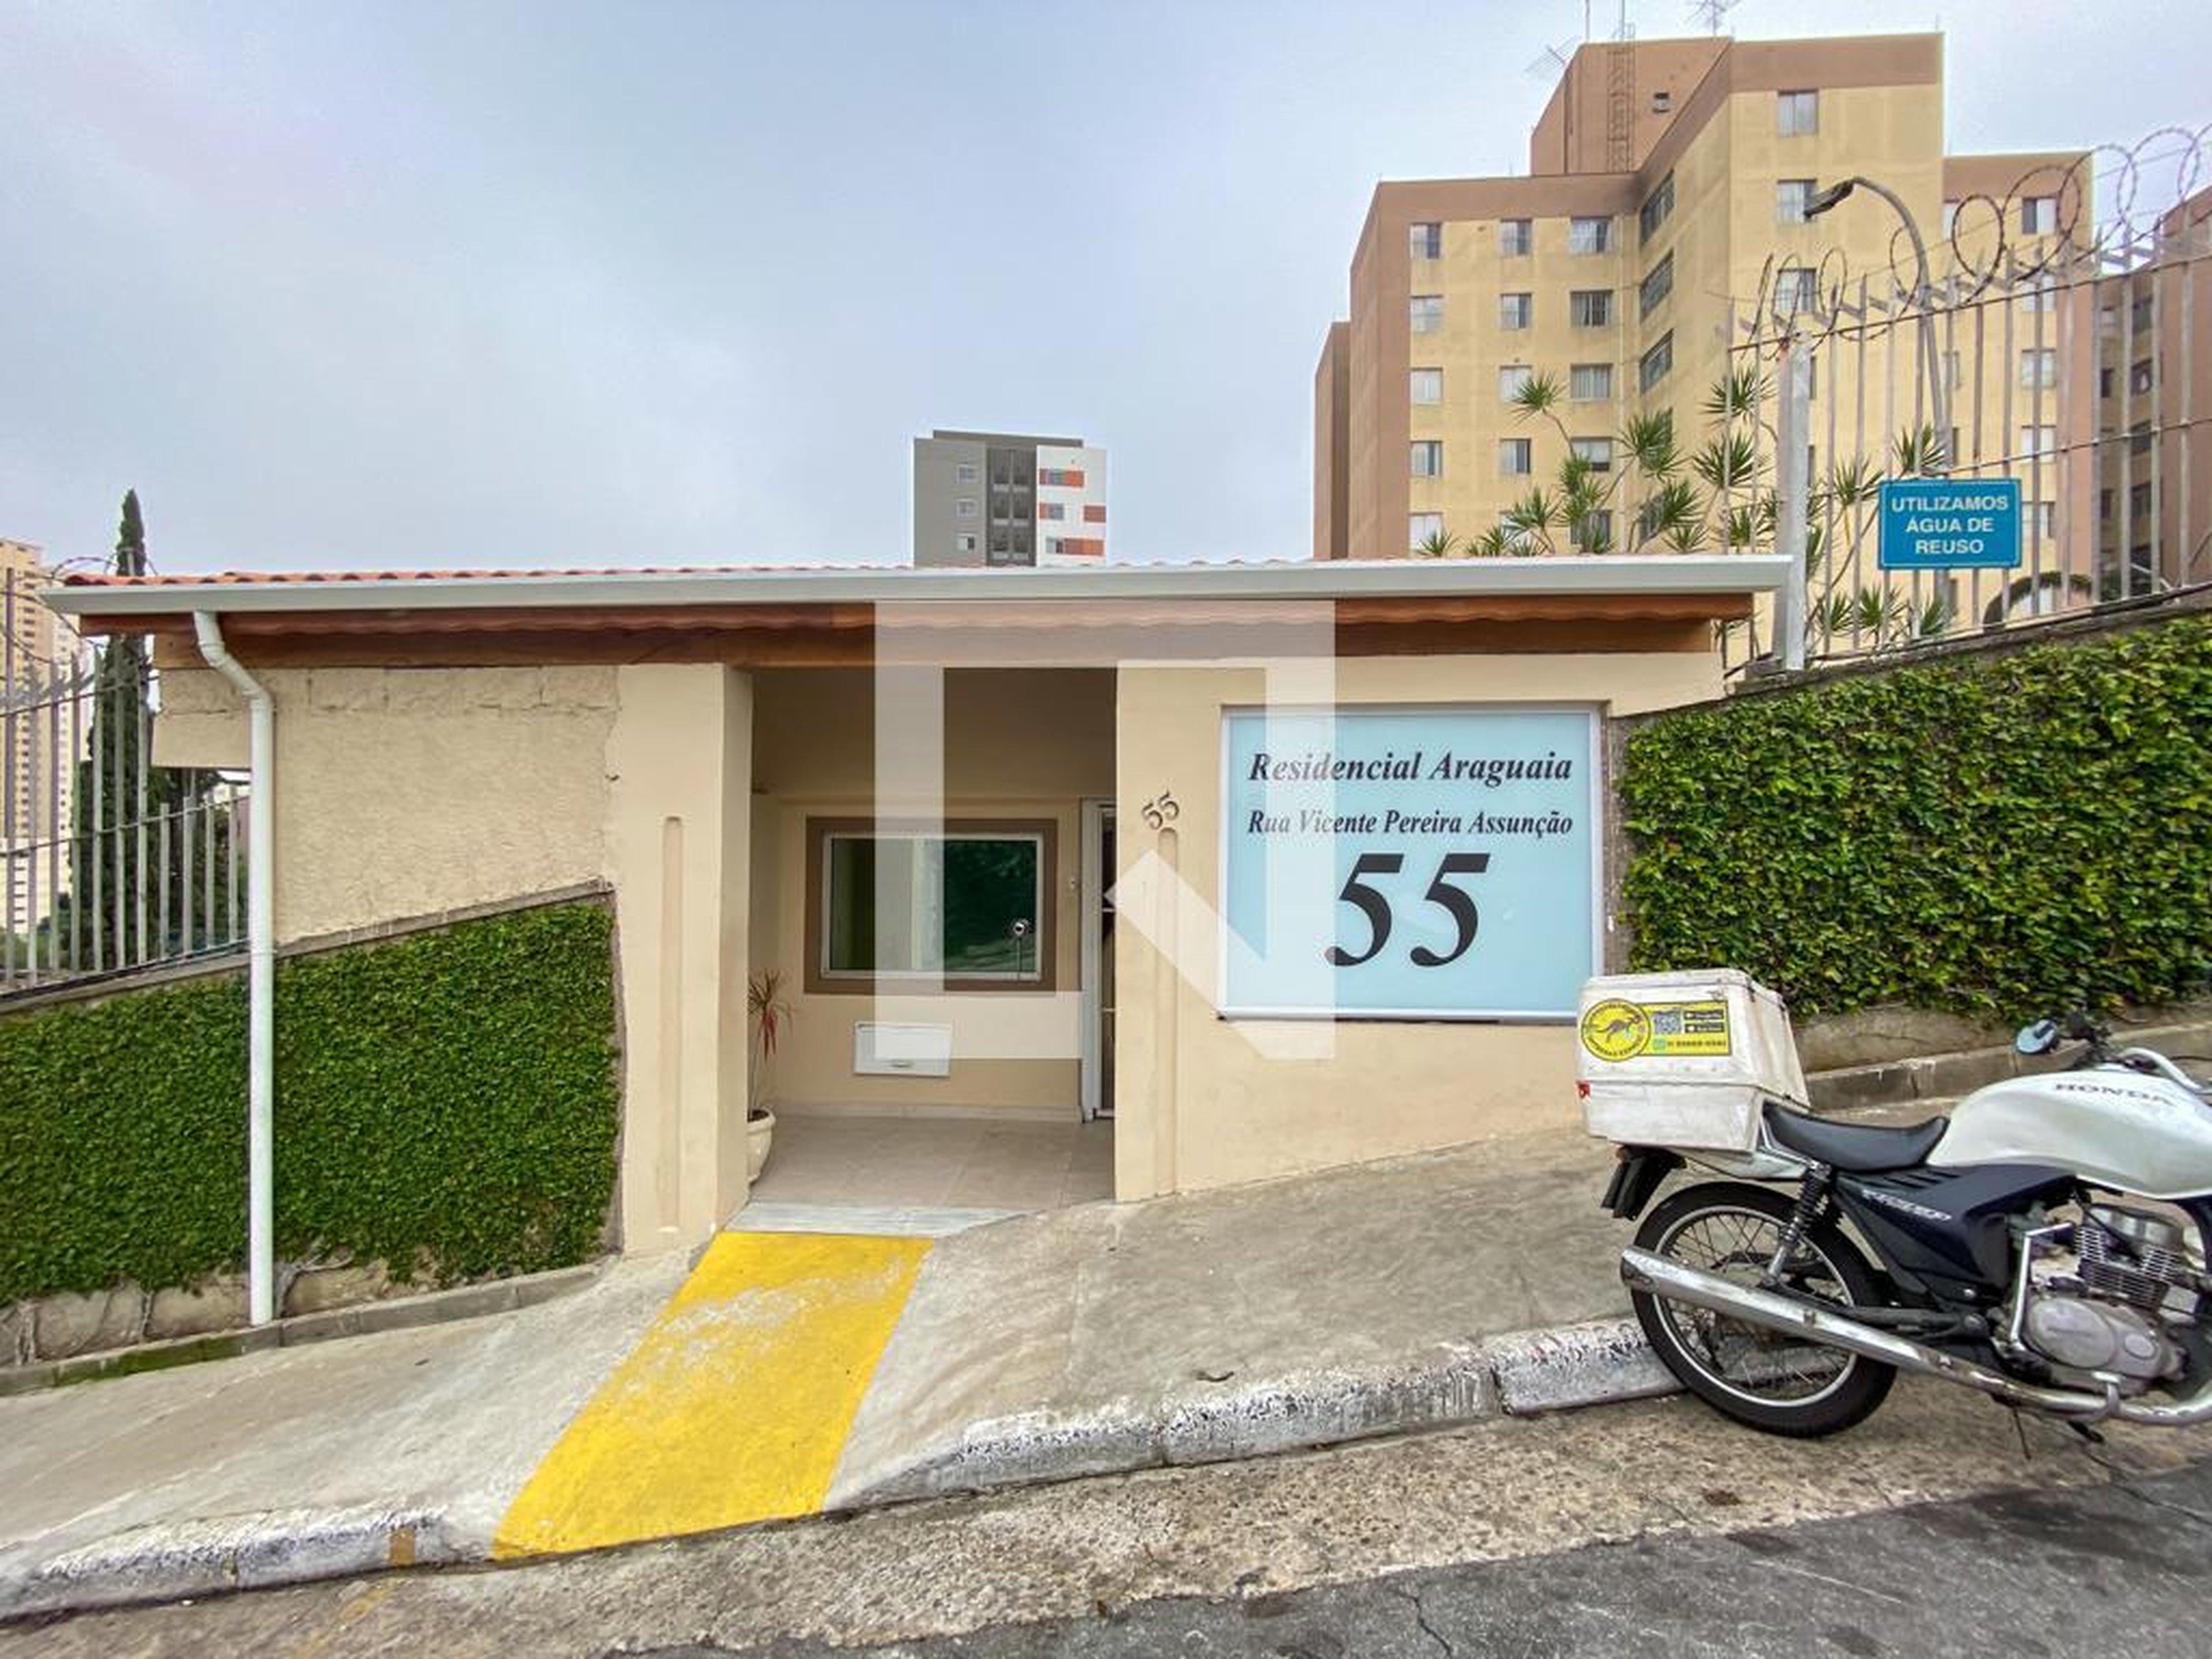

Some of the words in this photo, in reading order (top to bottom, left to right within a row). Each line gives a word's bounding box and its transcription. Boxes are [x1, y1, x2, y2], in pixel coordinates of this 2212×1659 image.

[1891, 495, 2009, 513] UTILIZAMOS
[1905, 514, 1963, 533] ÁGUA
[1967, 517, 1995, 533] DE
[1914, 539, 1985, 555] REUSO
[1248, 751, 1423, 781] Residencial
[1428, 751, 1573, 788] Araguaia
[1142, 789, 1179, 830] 55
[1248, 809, 1291, 834] Rua
[1298, 809, 1377, 834] Vicente
[1383, 809, 1462, 834] Pereira
[1467, 810, 1573, 839] Assunção
[1324, 852, 1491, 968] 55
[2054, 1083, 2176, 1107] HONDA
